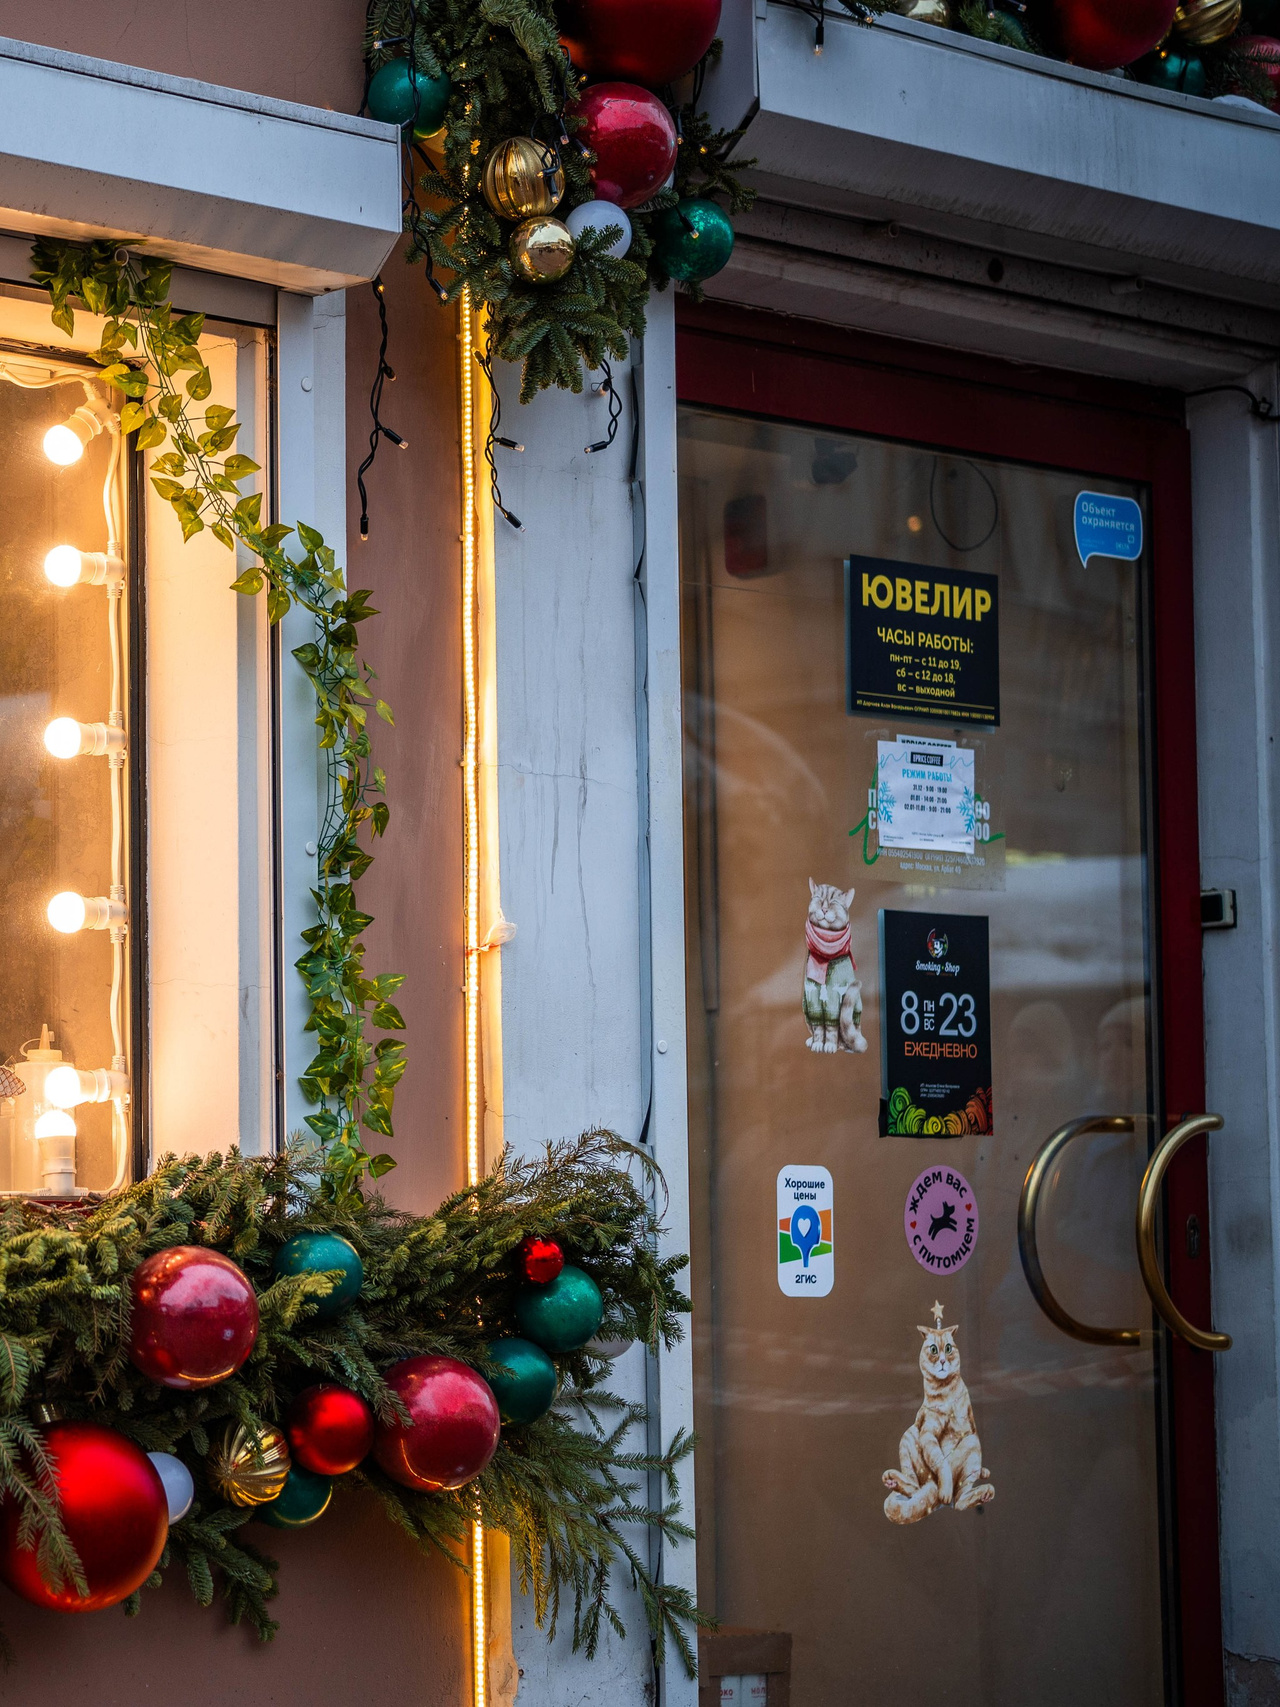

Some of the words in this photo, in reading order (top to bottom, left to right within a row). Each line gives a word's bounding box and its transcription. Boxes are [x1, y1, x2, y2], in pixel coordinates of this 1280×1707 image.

[1082, 501, 1115, 517] Объект
[1082, 516, 1135, 532] охраняется
[862, 573, 992, 622] ЮВЕЛИР
[877, 626, 915, 646] ЧАСЫ
[918, 631, 974, 654] РАБОТЫ:
[889, 653, 913, 665] пн-пт
[921, 657, 927, 666] с
[928, 656, 937, 667] 11
[938, 659, 949, 669] до
[950, 659, 962, 671] 19,
[896, 667, 906, 678] сб
[914, 670, 920, 679] с
[921, 669, 931, 681] 12
[932, 672, 943, 682] до
[944, 672, 956, 685] 18,
[897, 683, 907, 692] вс
[915, 685, 955, 698] выходной
[902, 768, 926, 780] РЕЖИМ
[927, 771, 953, 783] РАБОТЫ
[915, 960, 940, 976] Smoking
[944, 961, 960, 976] Shop
[900, 990, 920, 1035] 8
[939, 992, 977, 1037] 23
[924, 1000, 935, 1012] ПН
[924, 1018, 935, 1031] ВС
[904, 1041, 978, 1060] ЕЖЕДНЕВНО
[785, 1177, 825, 1190] Хорошие
[945, 1172, 968, 1199] вас
[793, 1191, 817, 1202] цены
[913, 1234, 922, 1246] с
[919, 1217, 975, 1269] питомцем
[795, 1274, 817, 1284] 2ГИС
